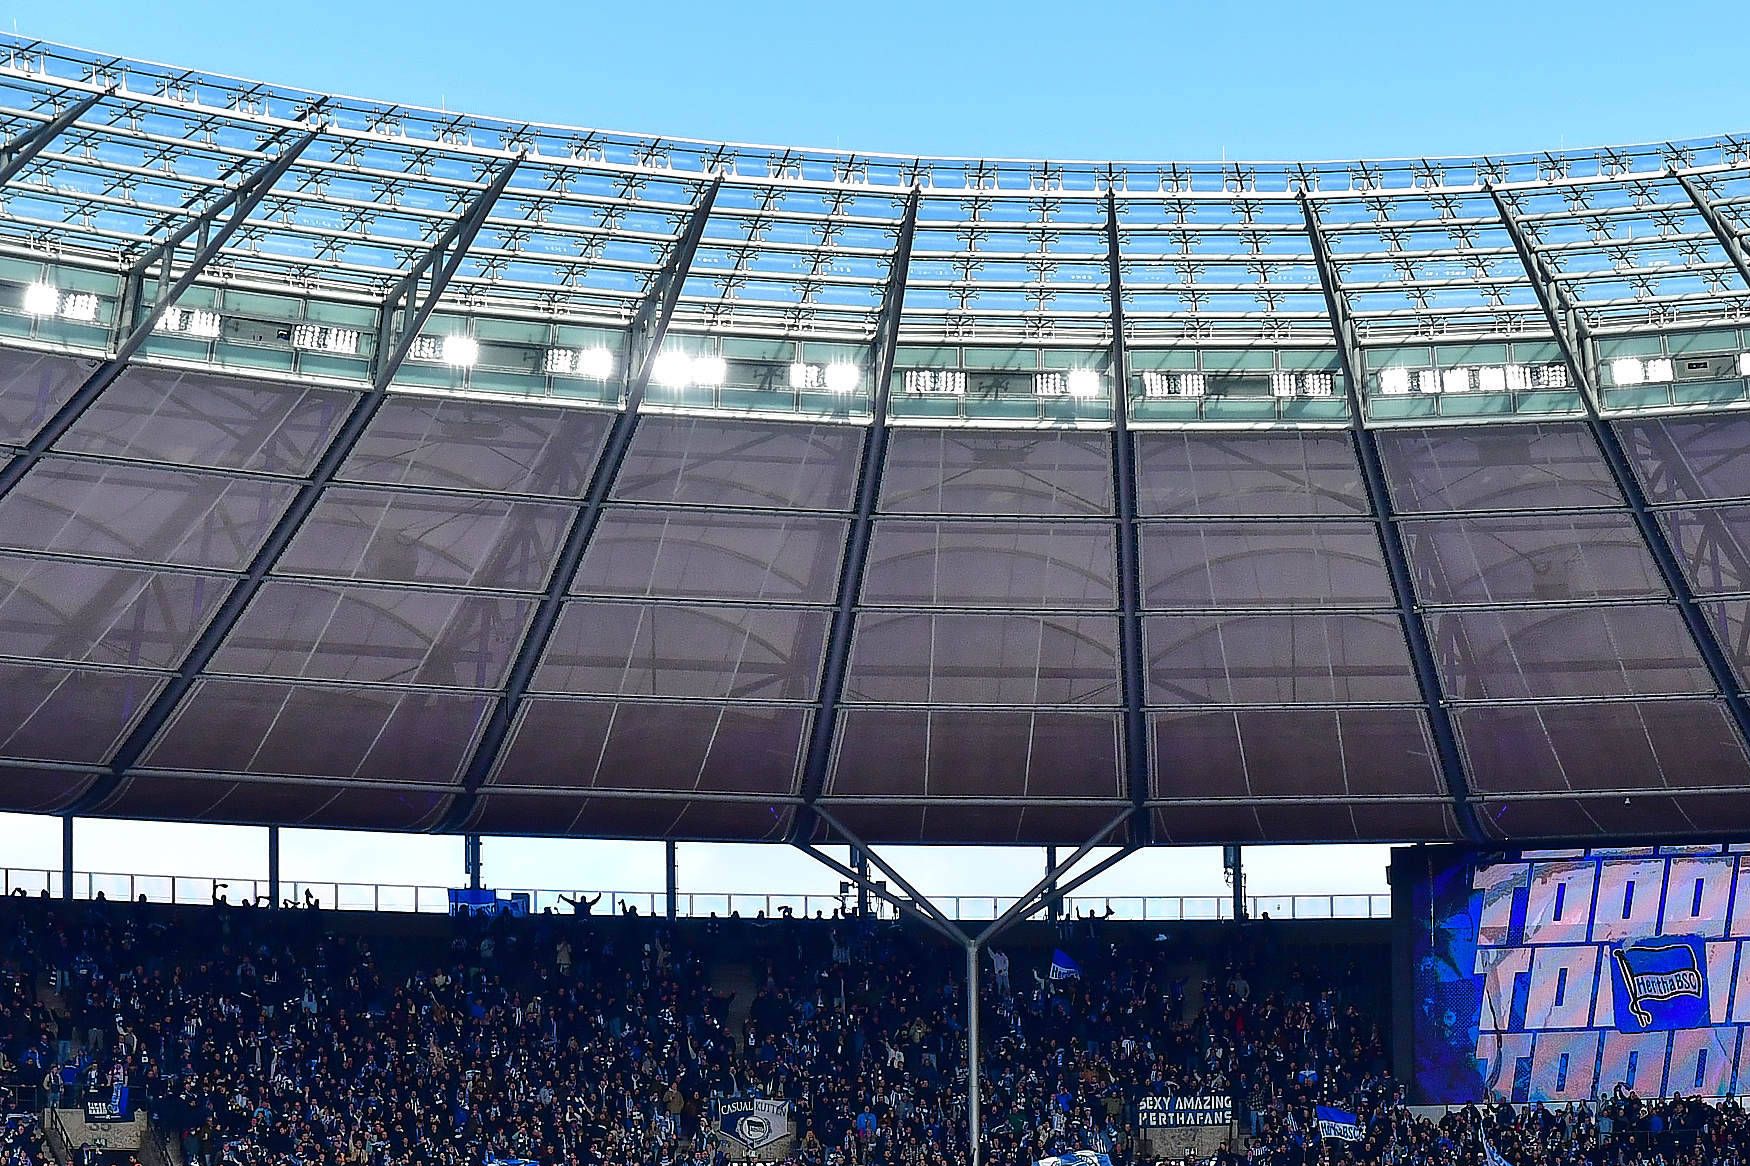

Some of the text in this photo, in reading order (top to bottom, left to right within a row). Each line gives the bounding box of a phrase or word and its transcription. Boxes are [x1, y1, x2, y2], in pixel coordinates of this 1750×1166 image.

[721, 1101, 754, 1115] CASUAL
[1139, 1095, 1232, 1111] SEXY AMAZING
[1138, 1110, 1233, 1126] HERTHAFANS
